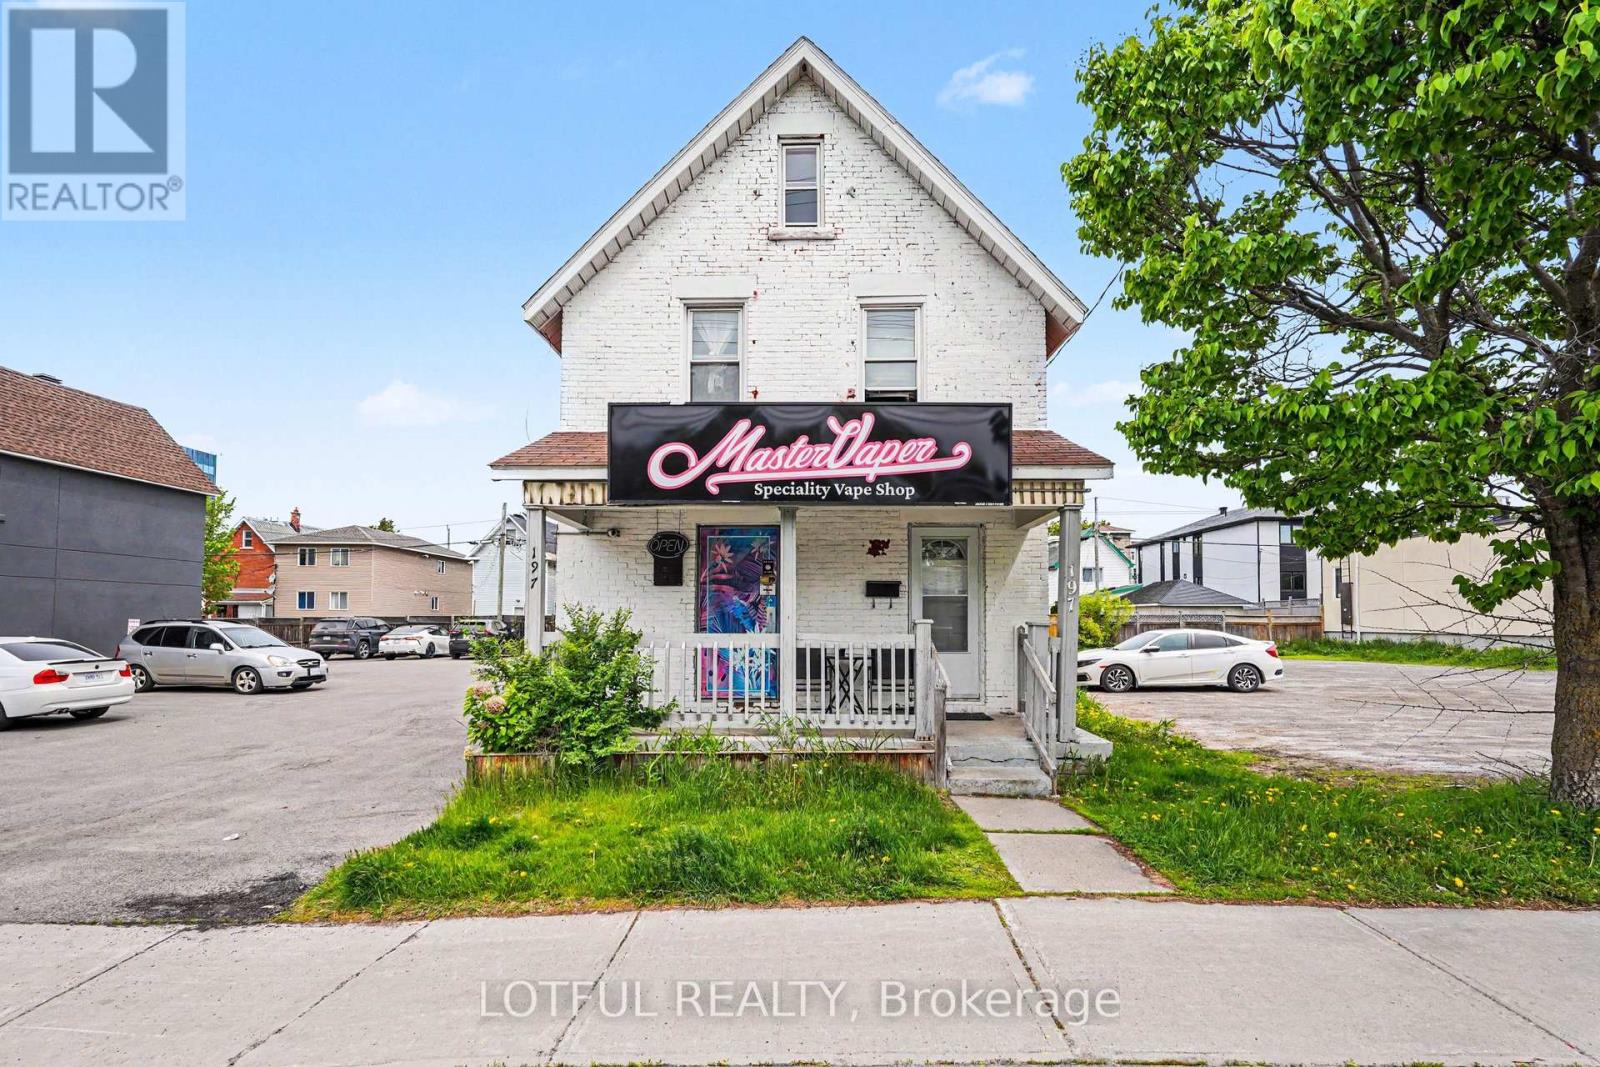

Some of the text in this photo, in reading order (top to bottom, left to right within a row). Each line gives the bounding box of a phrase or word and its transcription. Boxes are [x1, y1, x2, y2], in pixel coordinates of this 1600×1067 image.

[754, 482, 916, 500] Speciality Vape Shop
[650, 539, 685, 552] OPEN
[530, 546, 539, 590] 197
[1067, 564, 1078, 612] 197
